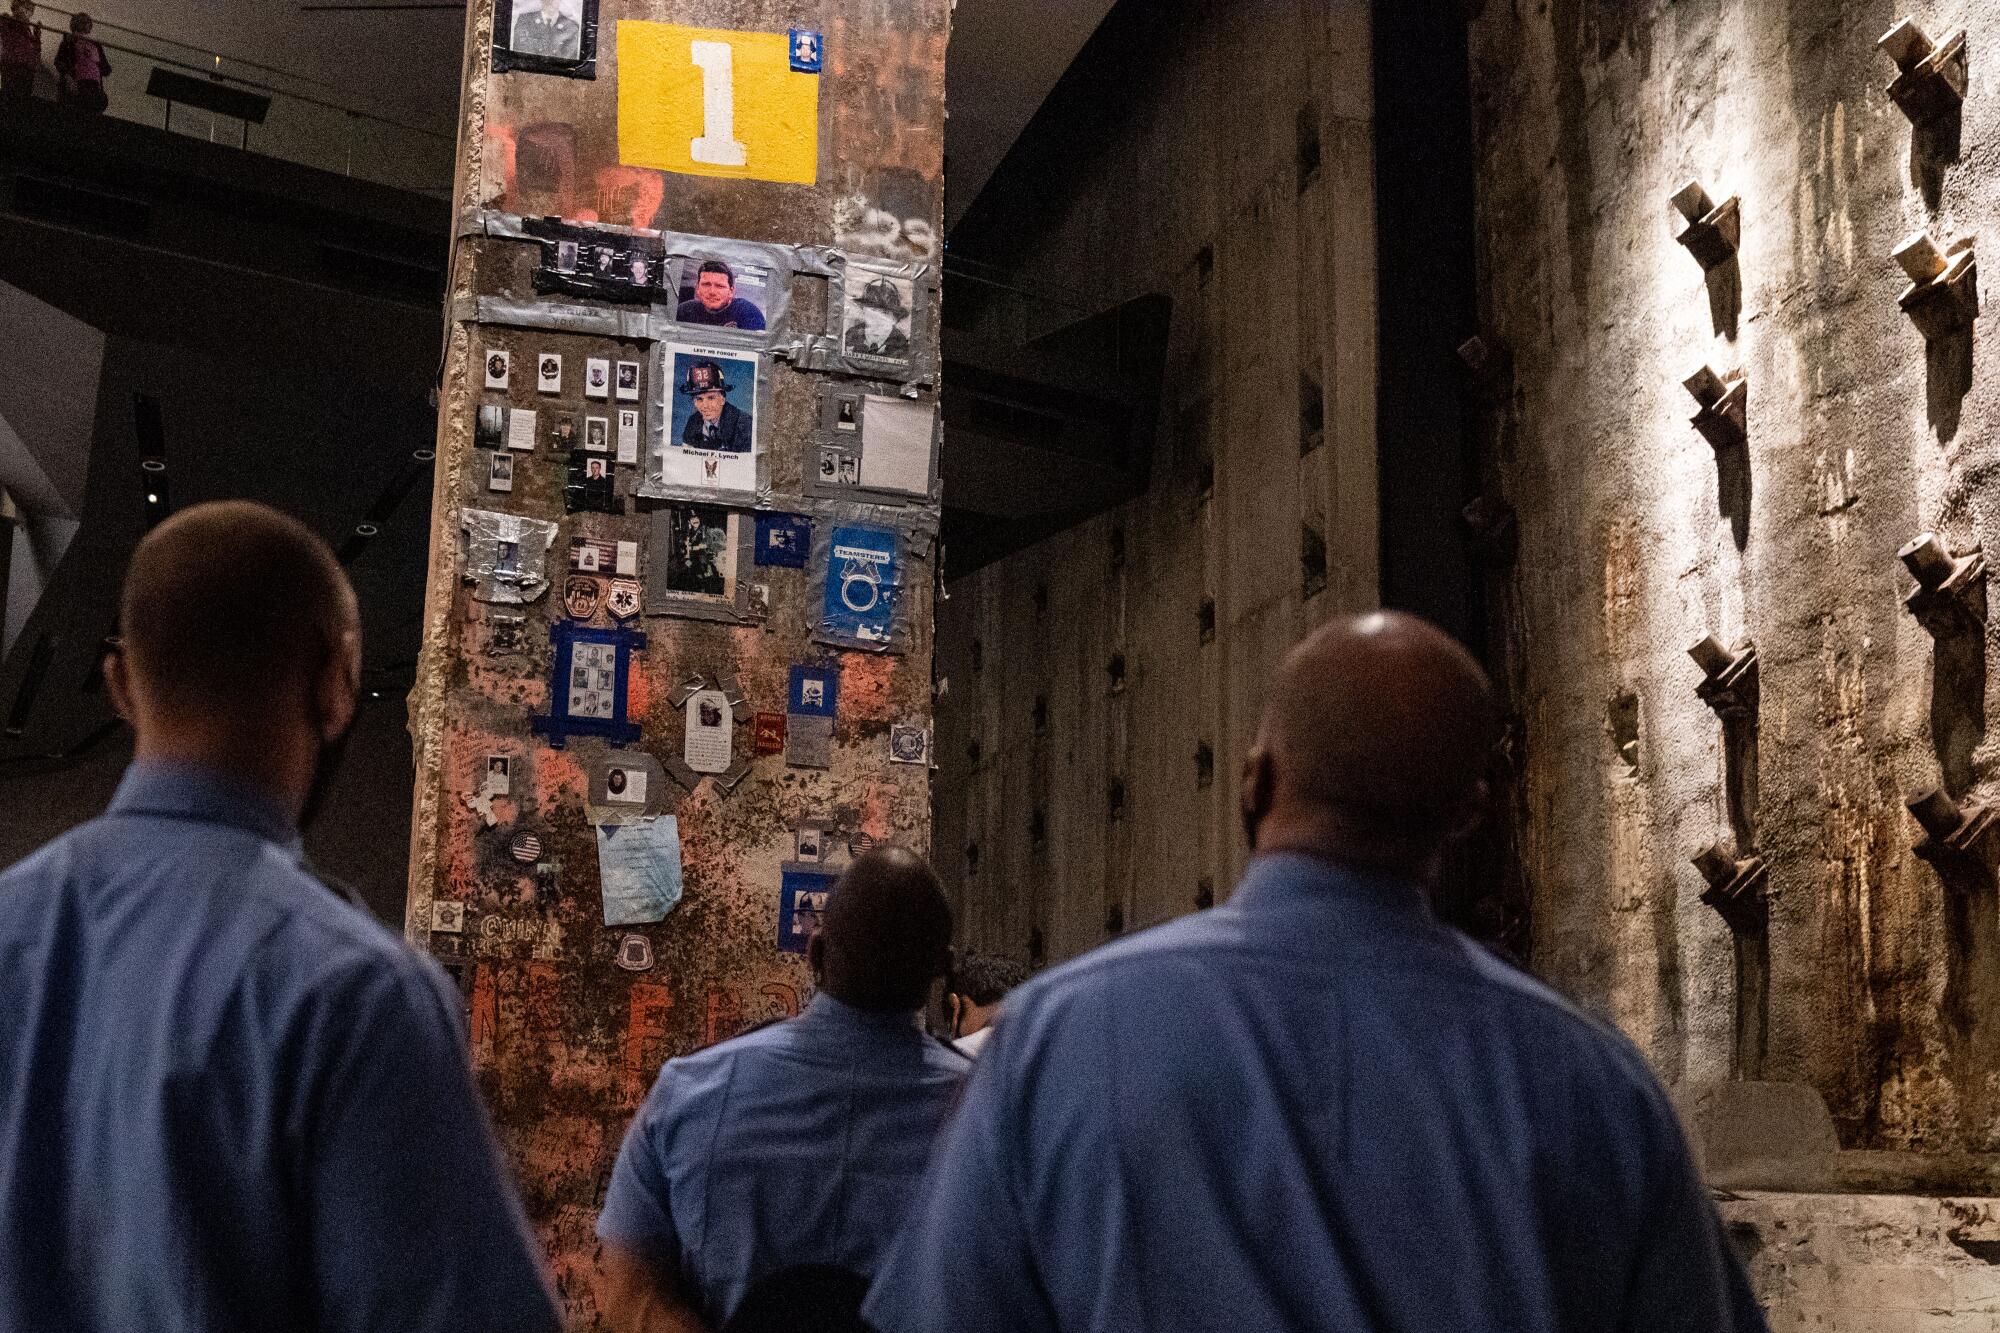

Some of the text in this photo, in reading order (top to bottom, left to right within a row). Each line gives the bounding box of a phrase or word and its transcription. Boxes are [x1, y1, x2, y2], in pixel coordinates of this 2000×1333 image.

[691, 40, 747, 166] 1
[716, 350, 738, 358] FORGET
[696, 369, 709, 380] 32
[682, 449, 709, 458] Michael
[718, 453, 739, 461] Lynch
[838, 549, 887, 561] TEAMSTERS
